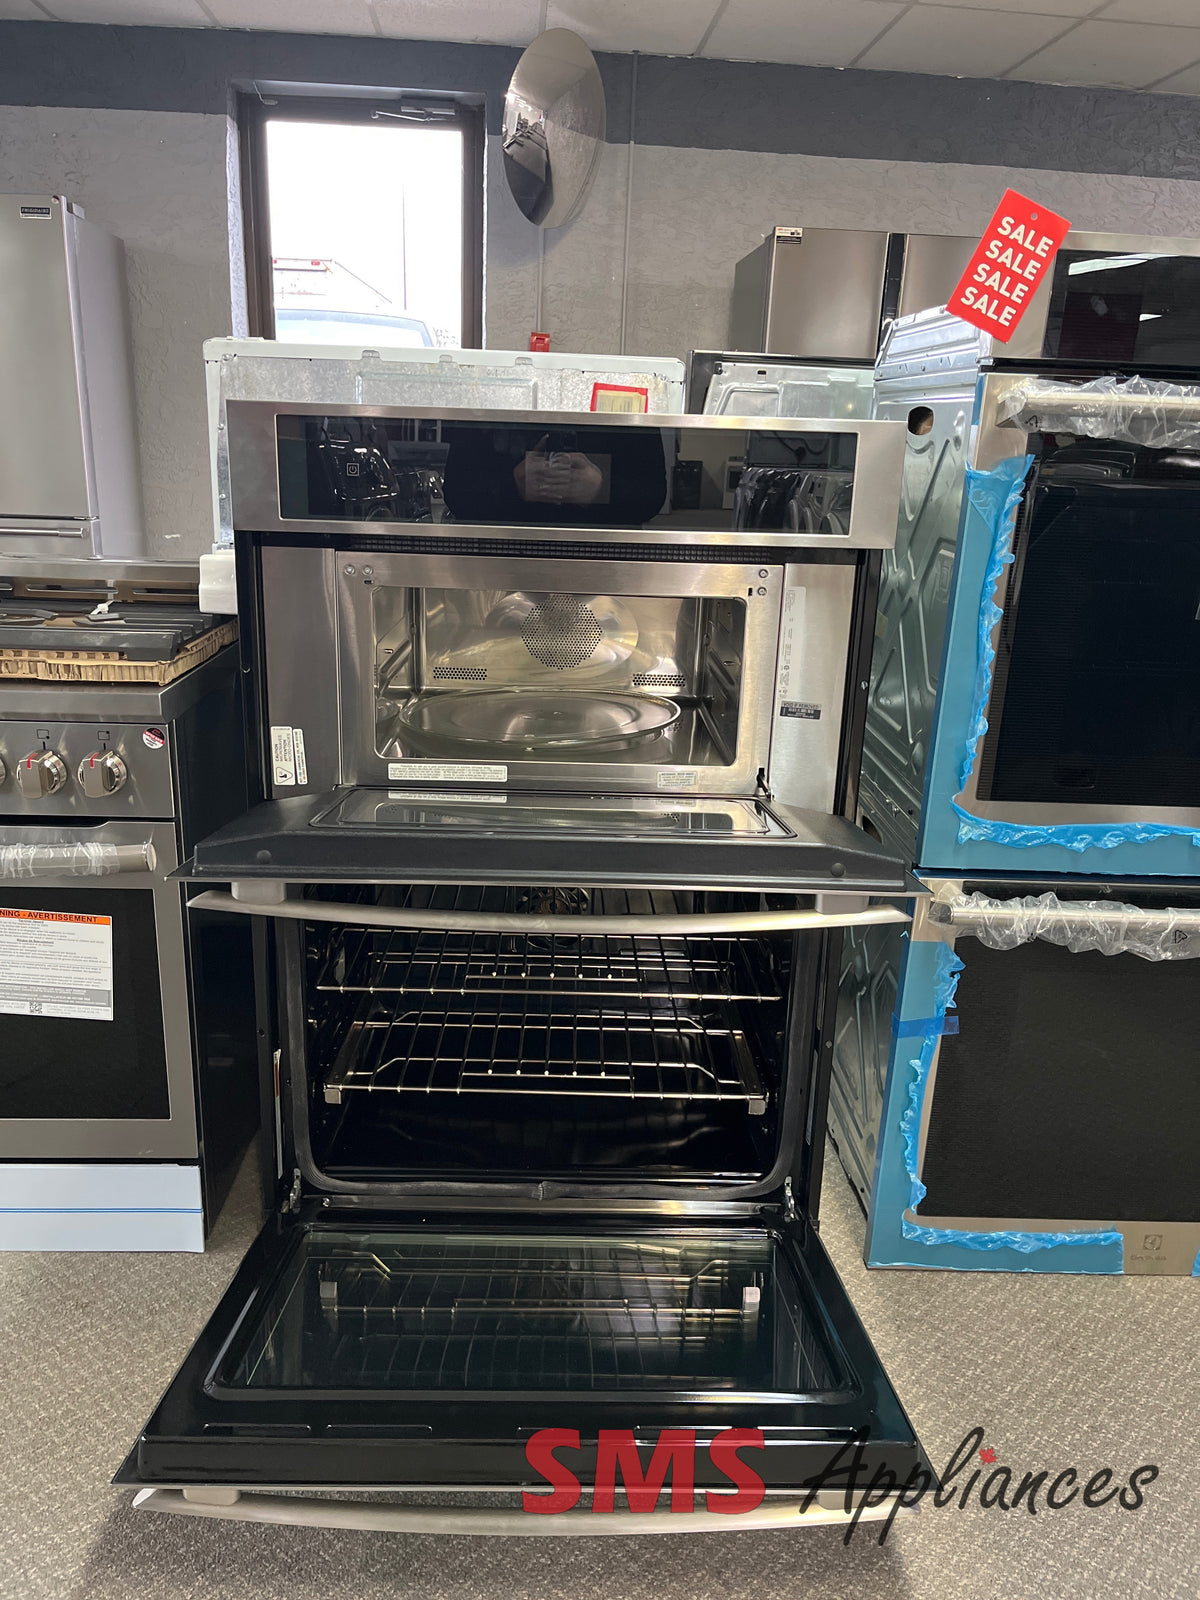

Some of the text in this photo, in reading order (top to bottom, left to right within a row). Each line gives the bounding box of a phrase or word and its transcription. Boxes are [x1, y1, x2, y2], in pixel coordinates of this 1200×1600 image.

[997, 216, 1054, 258] SALE
[985, 239, 1041, 281] SALE
[972, 263, 1029, 304] SALE
[960, 286, 1017, 327] SALE
[28, 911, 97, 922] AVERTISSEMENT
